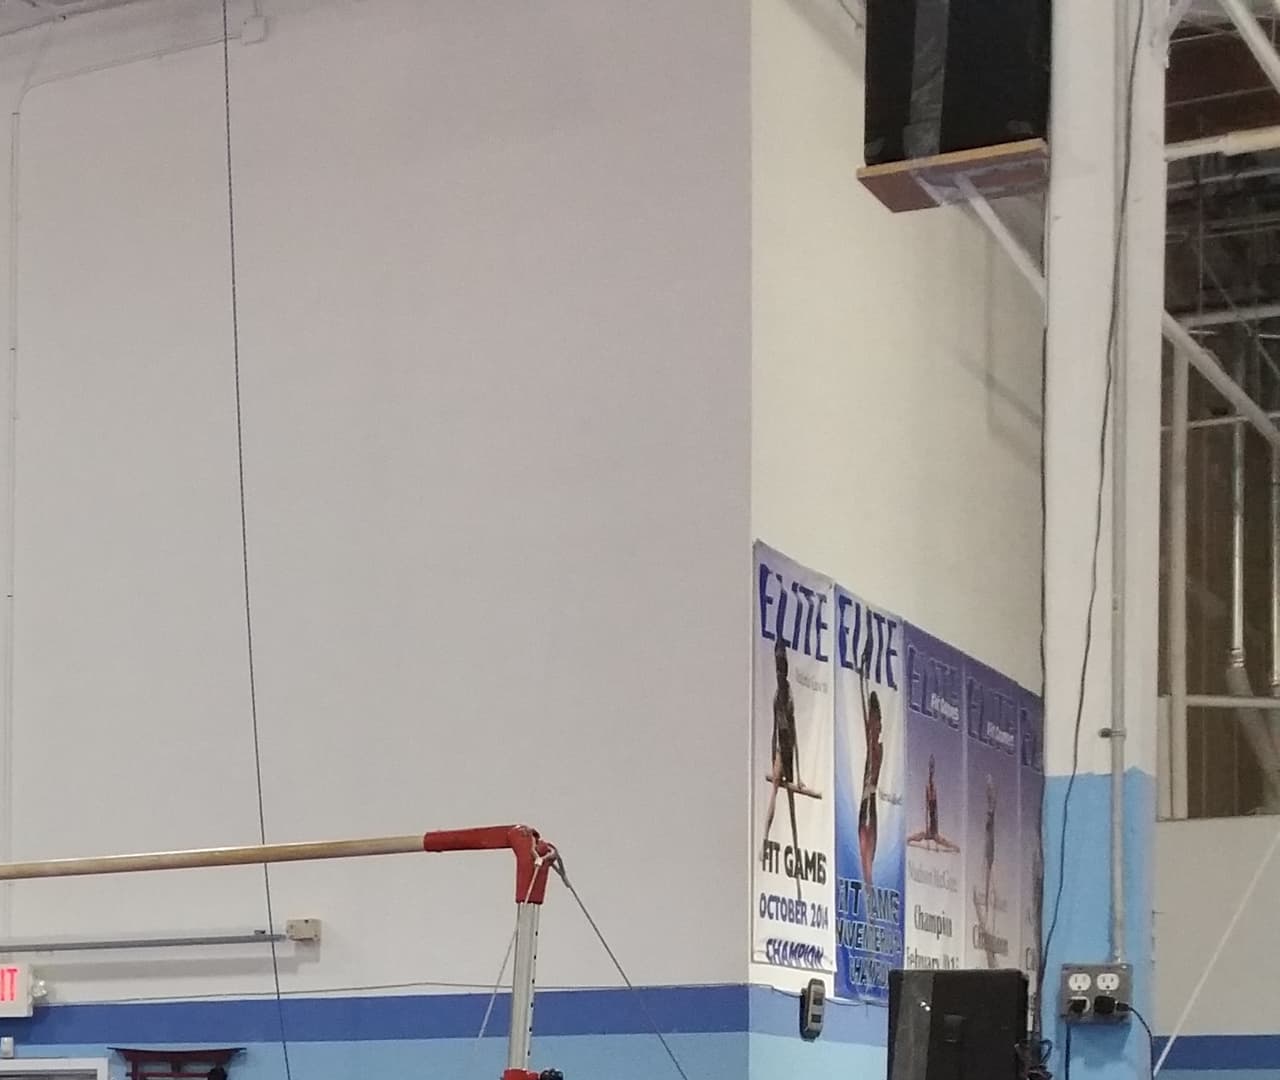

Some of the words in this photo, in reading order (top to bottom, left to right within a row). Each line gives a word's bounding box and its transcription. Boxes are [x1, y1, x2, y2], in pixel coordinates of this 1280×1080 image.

[759, 563, 829, 662] ELITE
[838, 594, 898, 691] ELITE
[762, 838, 781, 874] FIT
[759, 892, 807, 926] OCTOBER
[765, 938, 825, 969] CHAMPION
